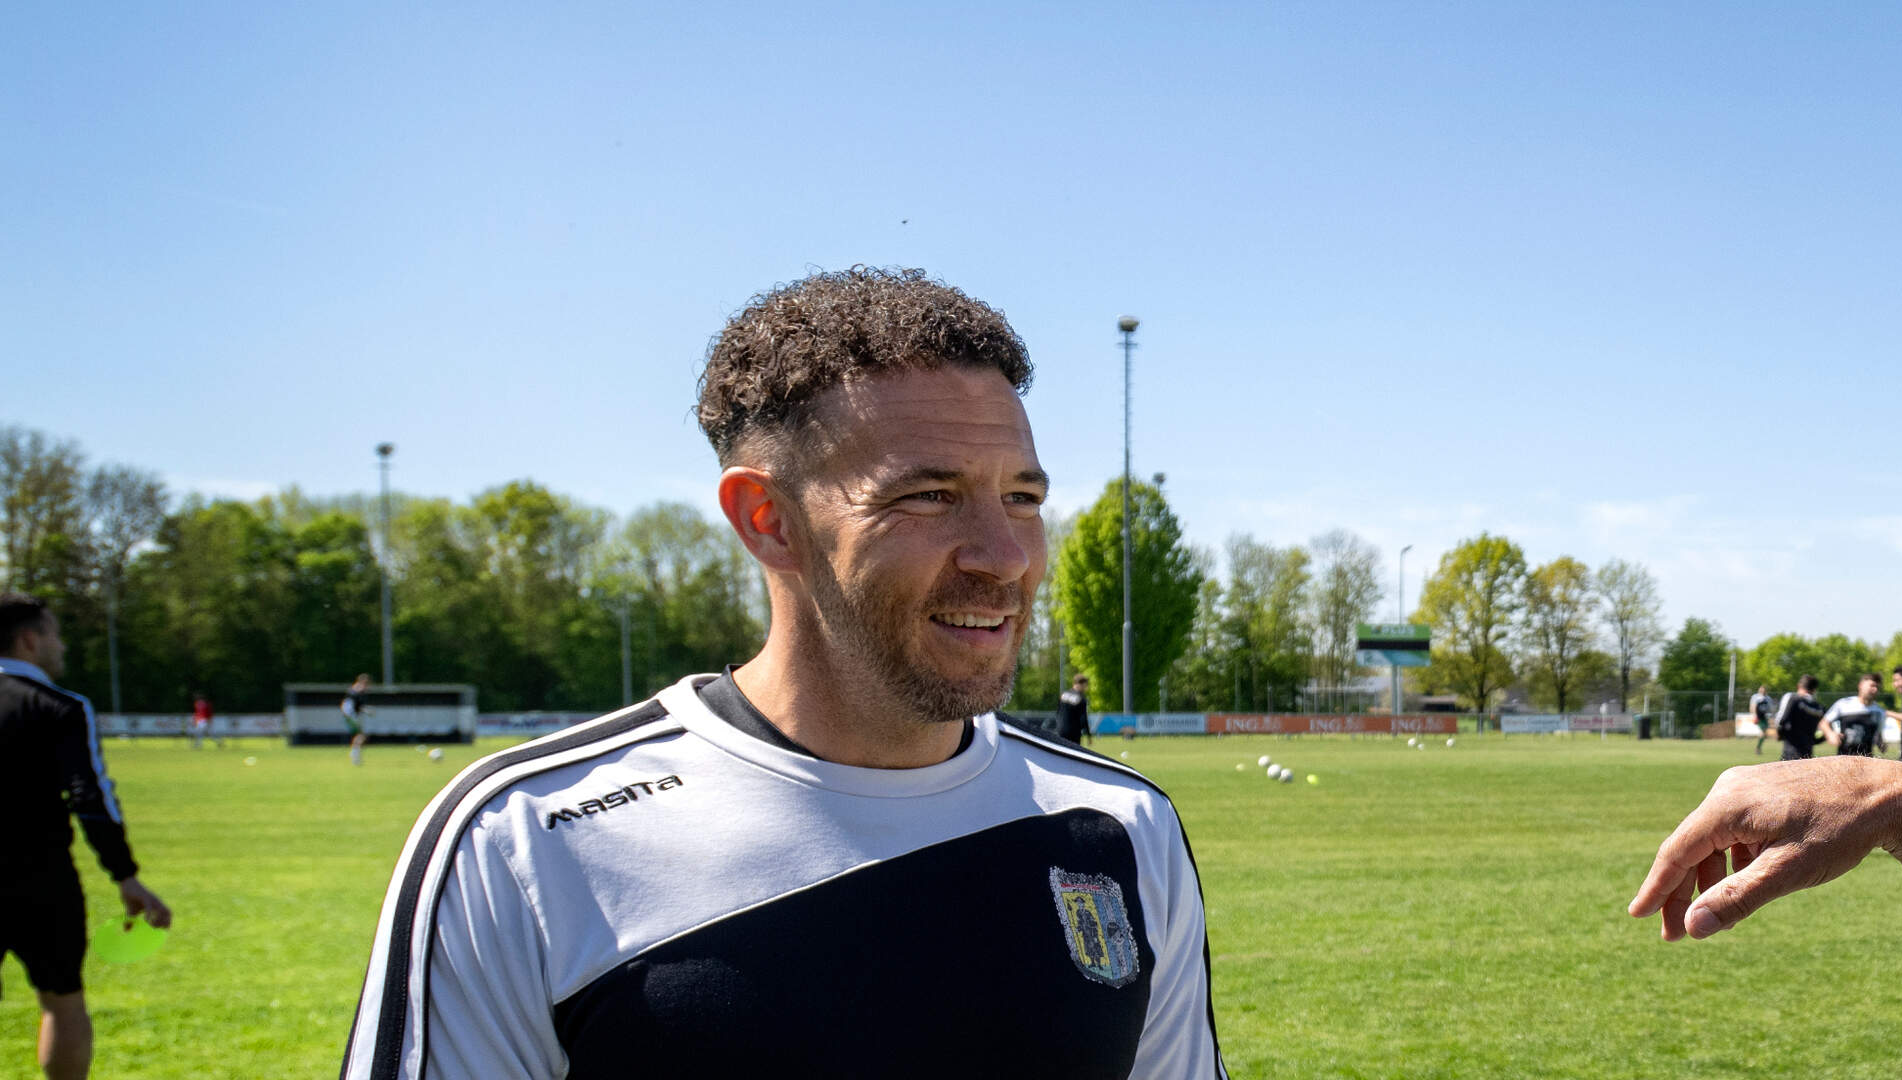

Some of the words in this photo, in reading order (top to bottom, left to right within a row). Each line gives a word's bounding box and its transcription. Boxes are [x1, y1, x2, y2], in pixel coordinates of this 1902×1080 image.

[1226, 718, 1257, 731] ING
[1310, 718, 1341, 731] ING
[1391, 718, 1421, 731] ING
